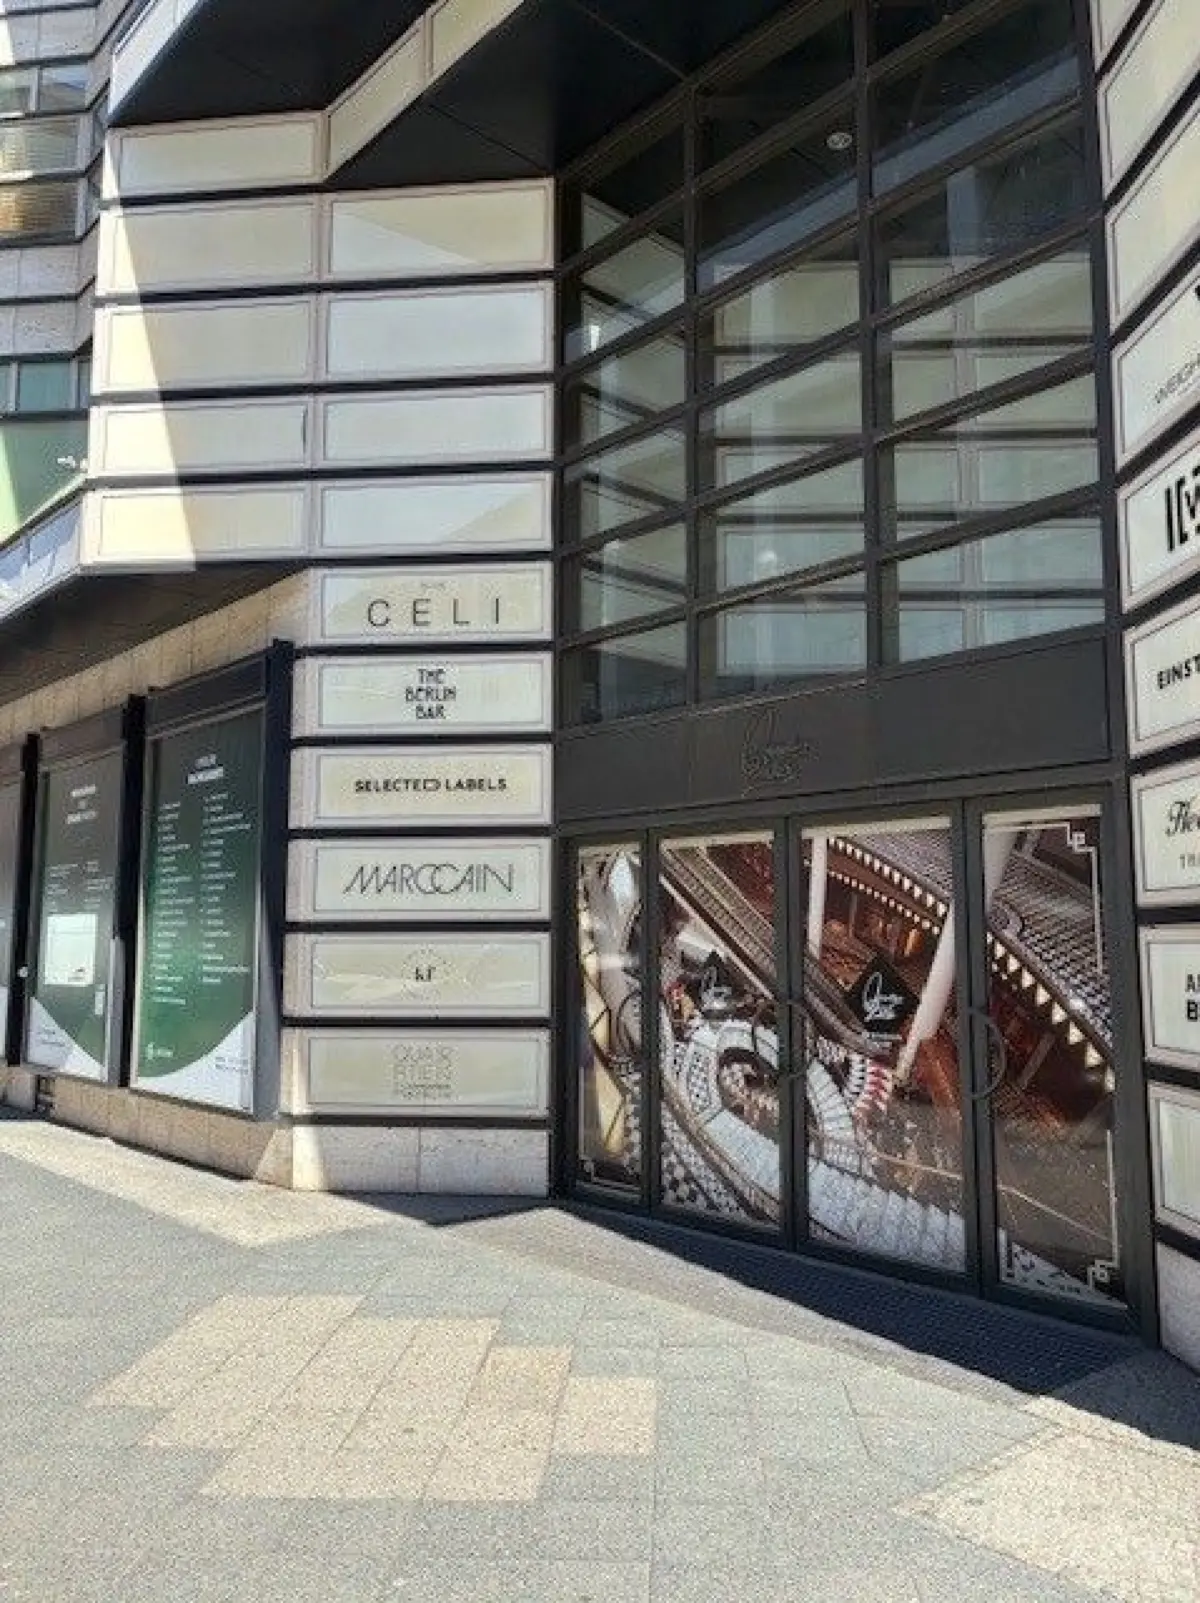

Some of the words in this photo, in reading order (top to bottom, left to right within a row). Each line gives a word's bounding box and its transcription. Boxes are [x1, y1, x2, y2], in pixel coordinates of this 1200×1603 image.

[367, 598, 500, 627] CELI
[417, 668, 446, 684] THE
[405, 685, 457, 702] BERLIN
[415, 704, 446, 720] BAR
[445, 776, 507, 792] LABELS
